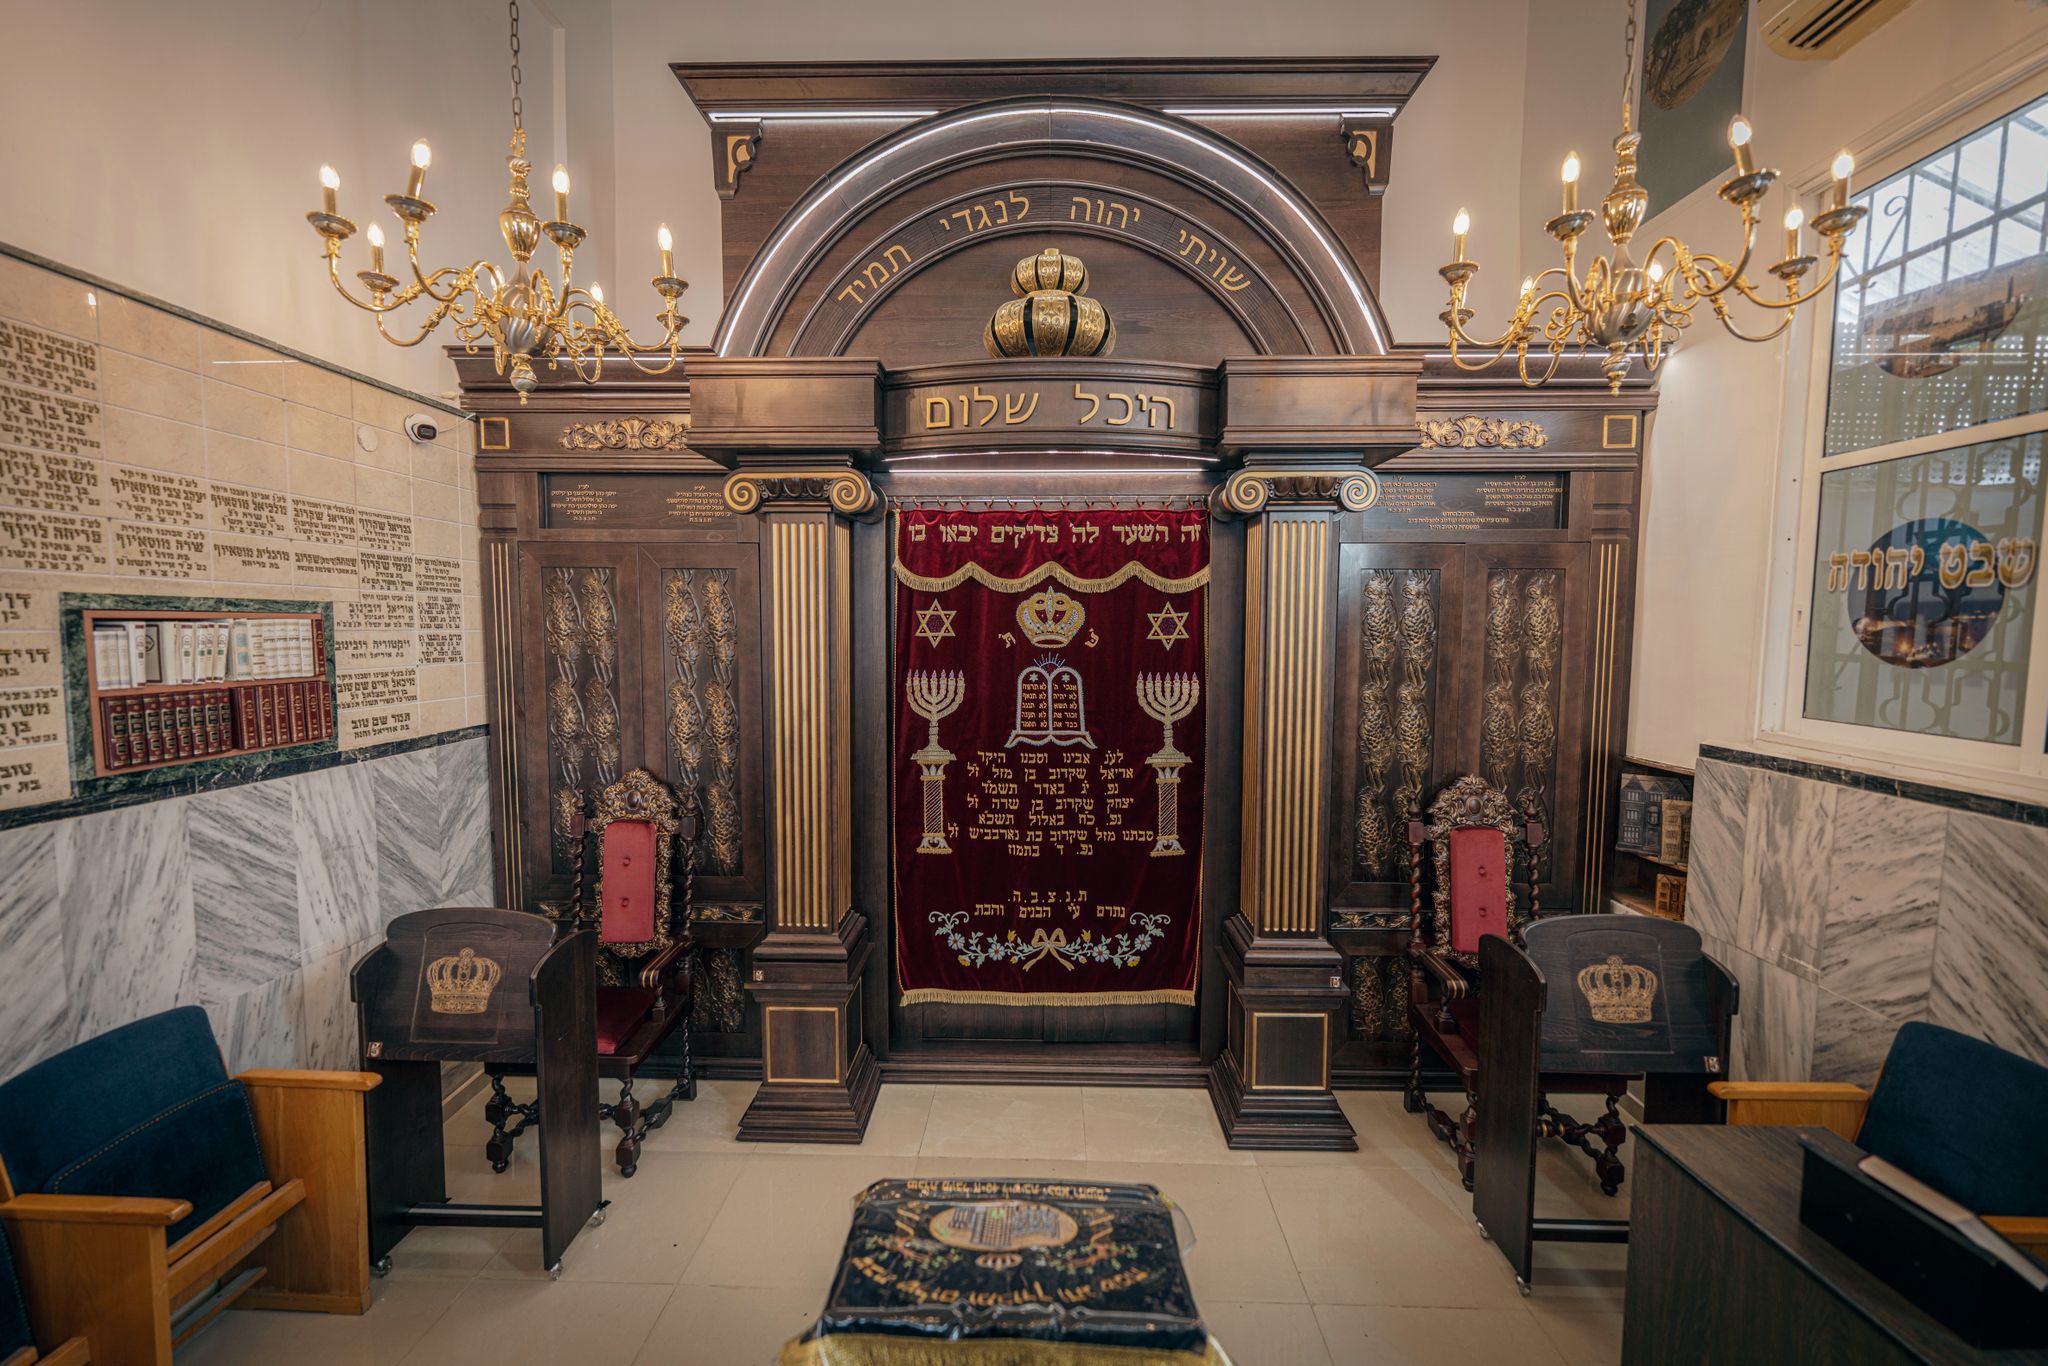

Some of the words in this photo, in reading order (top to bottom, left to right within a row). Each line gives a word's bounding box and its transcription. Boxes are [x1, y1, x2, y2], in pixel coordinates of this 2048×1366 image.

[939, 190, 1031, 232] לנגדי
[1070, 196, 1140, 229] יהוה
[1178, 228, 1251, 292] שויתי
[838, 244, 911, 304] תמיד
[926, 386, 1039, 429] שלום
[1073, 383, 1175, 430] היכל
[908, 523, 927, 544] בו
[938, 523, 978, 543] יבאו
[991, 523, 1059, 549] צדיקים
[1111, 523, 1169, 546] השער
[1181, 523, 1202, 543] זה
[1828, 544, 1925, 592] יהודה
[1939, 536, 2036, 589] שבט
[1039, 682, 1047, 691] לא
[1038, 692, 1047, 700] לא
[1069, 693, 1078, 701] לא
[1038, 701, 1047, 709] לא
[1038, 710, 1047, 718] לא
[1040, 720, 1048, 728] לא
[977, 751, 1007, 766] היקר
[1020, 752, 1049, 765] וסבנו
[1062, 752, 1090, 765] אבינו
[992, 764, 1013, 780] מזל
[1024, 768, 1037, 781] בן
[1099, 766, 1134, 780] אריאל
[1034, 782, 1065, 795] באדר
[991, 798, 1020, 810] שרה
[1031, 798, 1044, 812] בן
[1106, 798, 1134, 813] יצחק
[1028, 810, 1065, 826] באלול
[1026, 829, 1042, 842] בת
[1095, 827, 1116, 842] מזל
[1122, 829, 1154, 842] סבתנו
[1008, 844, 1041, 857] בתמוז
[974, 903, 1005, 917] והבת
[1019, 905, 1051, 919] הבנים
[1096, 904, 1126, 918] נתרם
